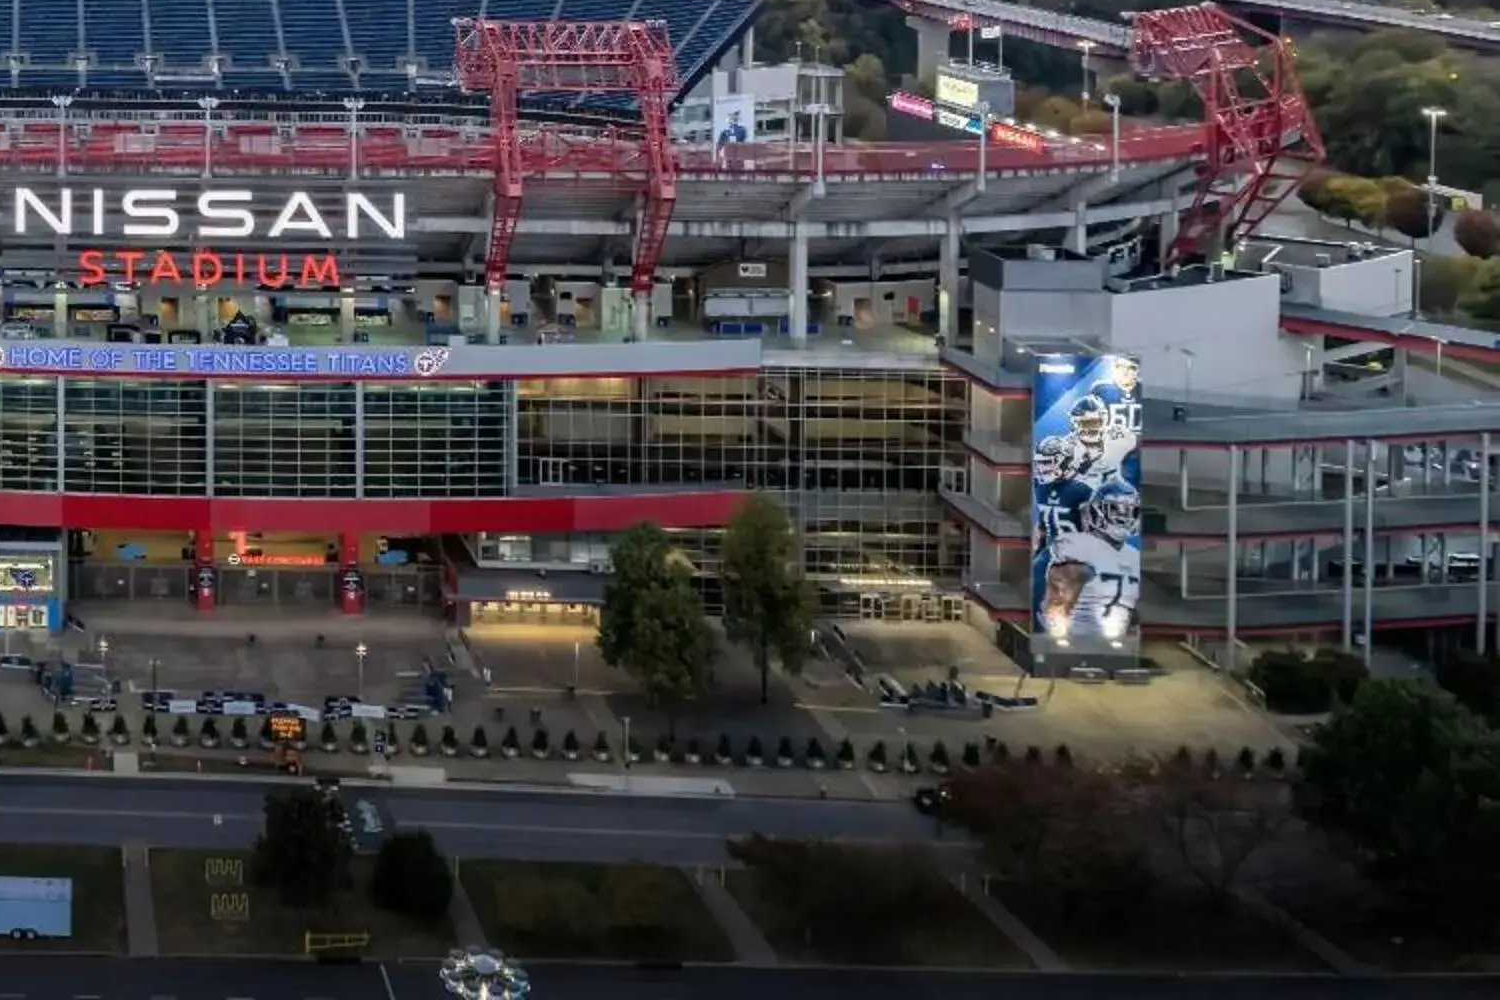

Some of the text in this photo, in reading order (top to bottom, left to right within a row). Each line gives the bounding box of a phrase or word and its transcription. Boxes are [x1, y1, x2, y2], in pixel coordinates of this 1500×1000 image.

[14, 187, 405, 240] NISSAN
[79, 249, 340, 287] STADIUM
[8, 345, 408, 374] HOME OF THE TENNESSEE TITANS
